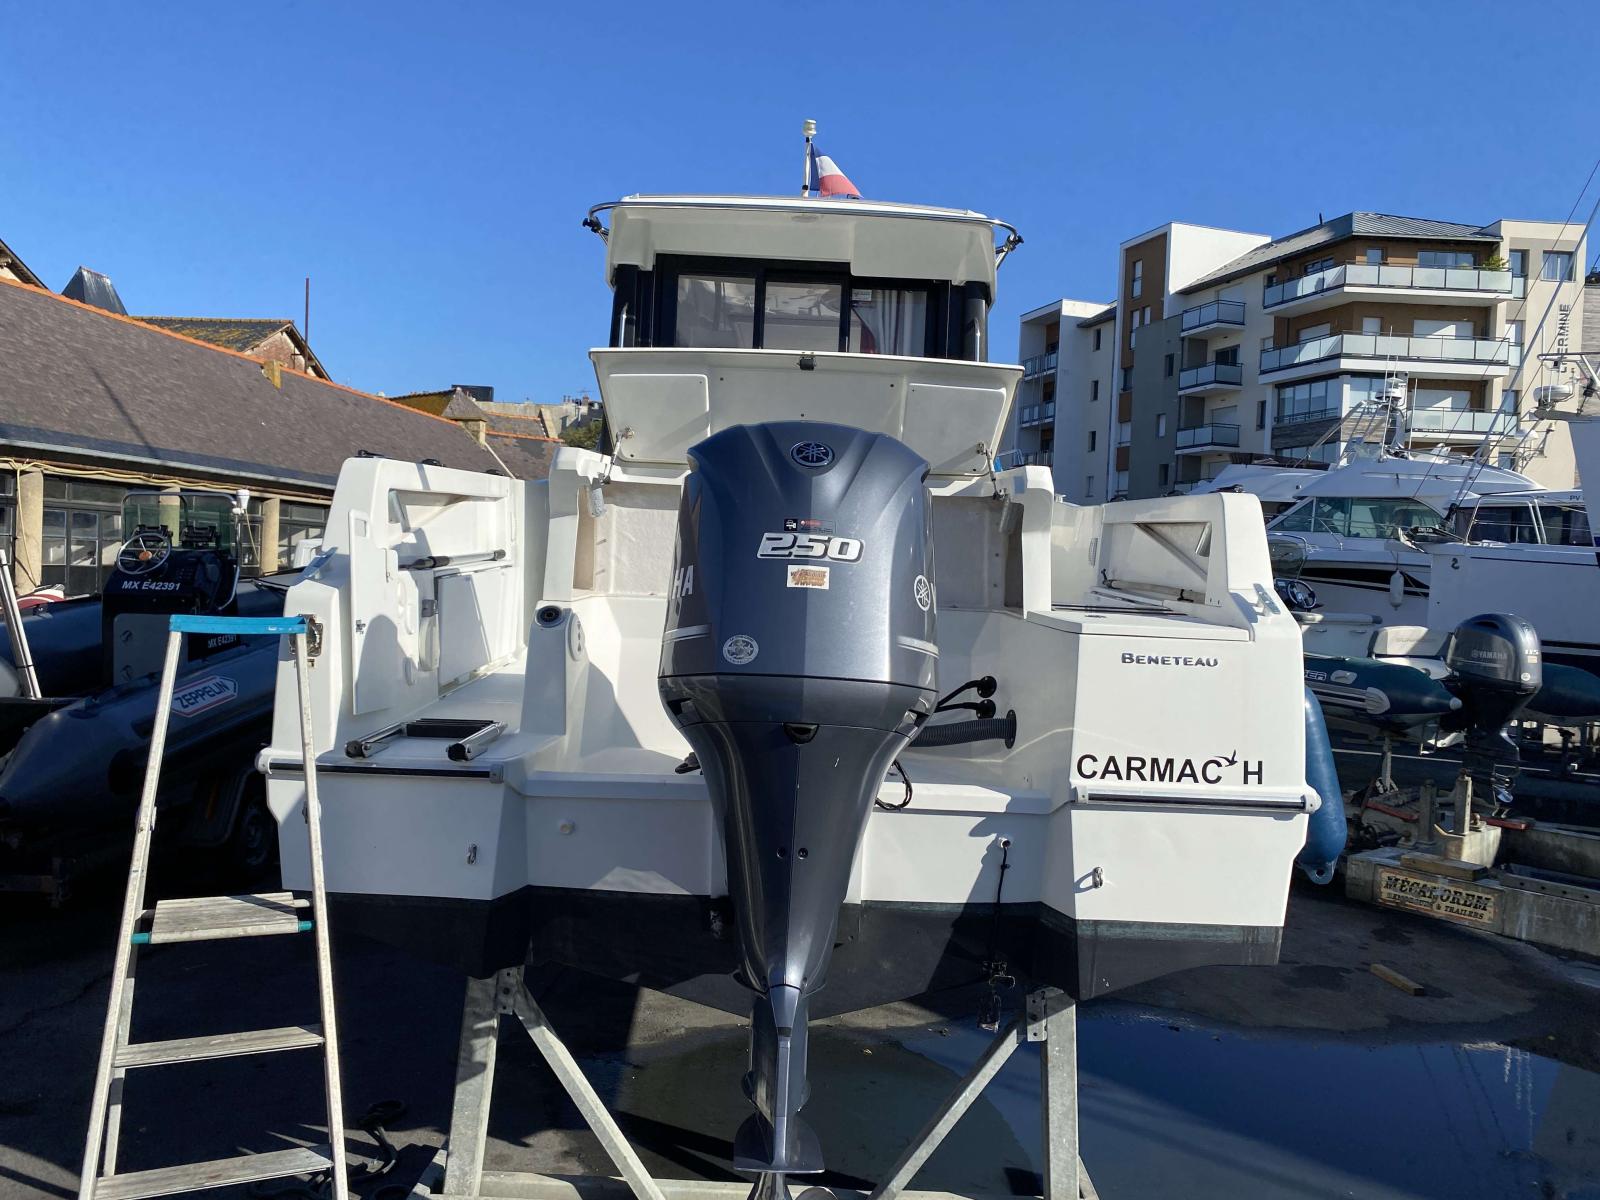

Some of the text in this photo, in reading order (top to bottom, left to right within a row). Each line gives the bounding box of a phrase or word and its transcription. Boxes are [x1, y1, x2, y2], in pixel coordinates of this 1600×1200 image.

[757, 533, 866, 563] 250
[122, 581, 181, 591] MX E42391
[1479, 650, 1509, 660] YAMAHA
[174, 682, 231, 709] ZEPPELIN
[1444, 905, 1485, 920] TRAILERS
